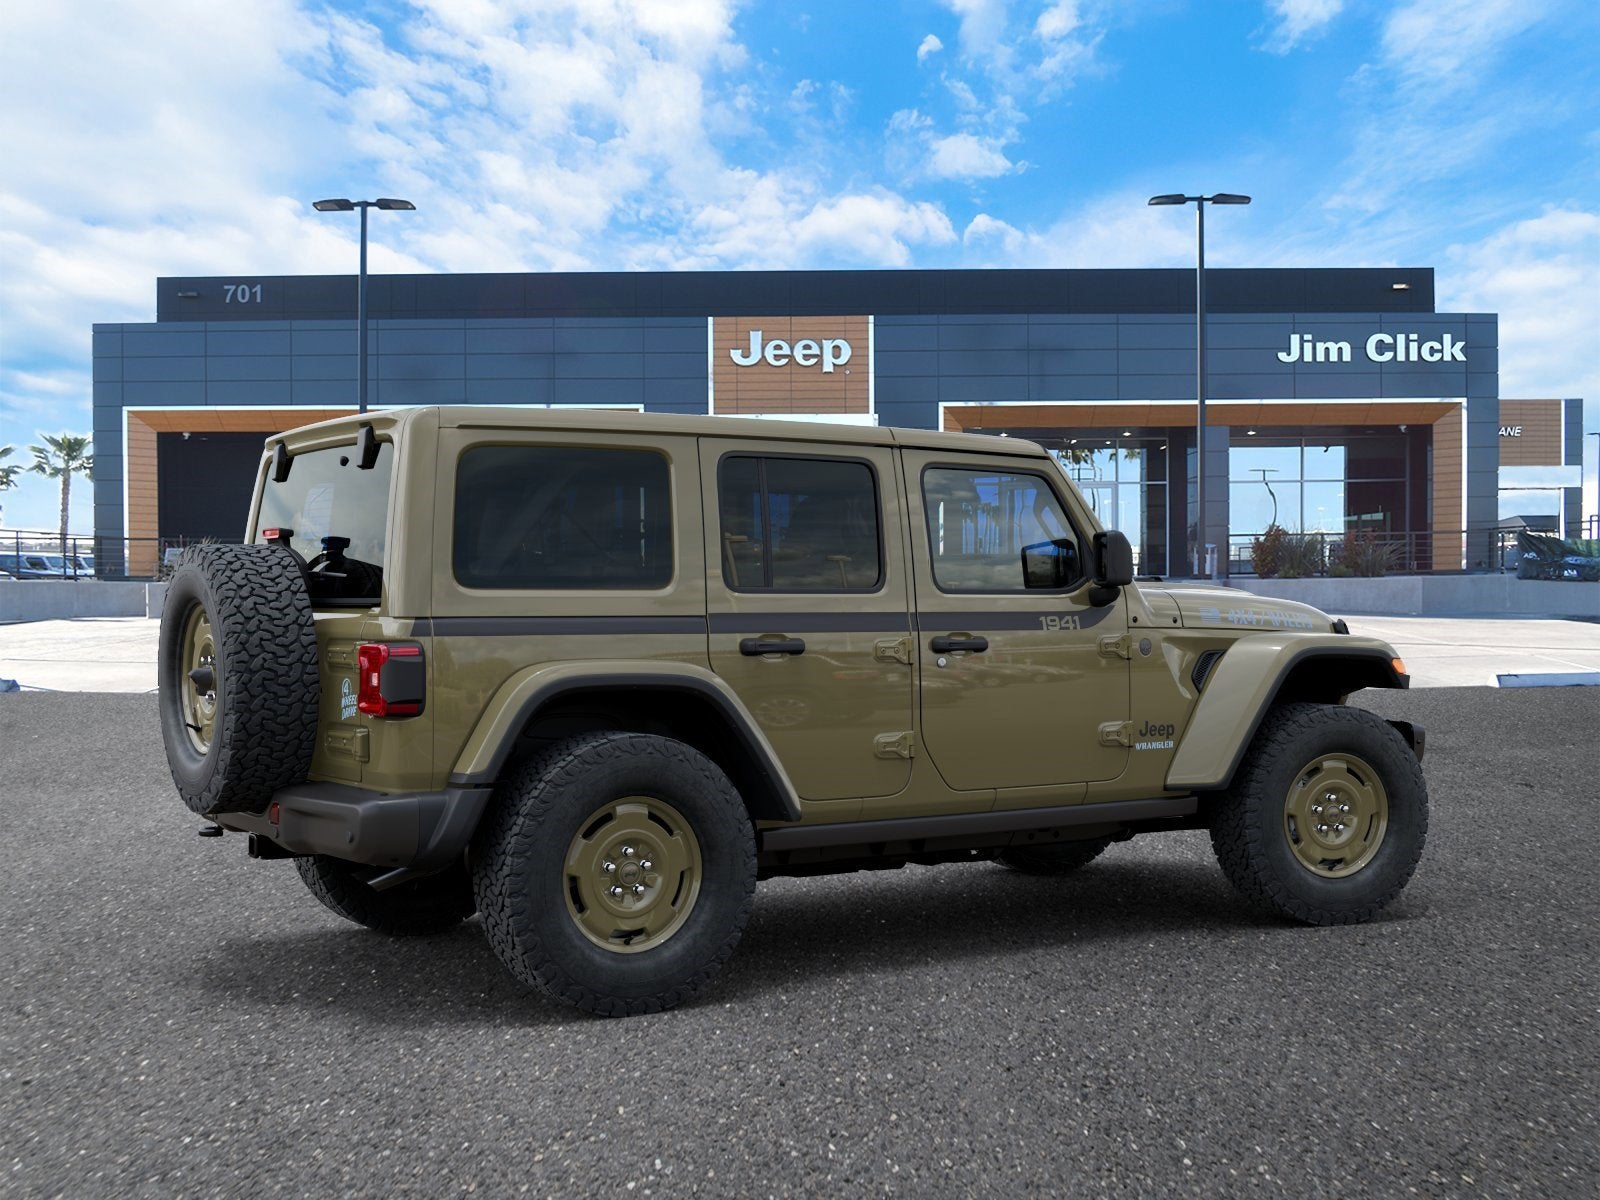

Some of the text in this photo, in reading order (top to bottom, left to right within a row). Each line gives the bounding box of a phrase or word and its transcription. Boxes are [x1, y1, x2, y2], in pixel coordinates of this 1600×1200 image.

[223, 284, 262, 304] 701
[729, 329, 852, 374] Jeep
[1277, 332, 1467, 363] Jim Click
[1039, 615, 1081, 631] 1941
[1139, 720, 1175, 739] Jeep
[1135, 740, 1174, 750] WRANGLER
